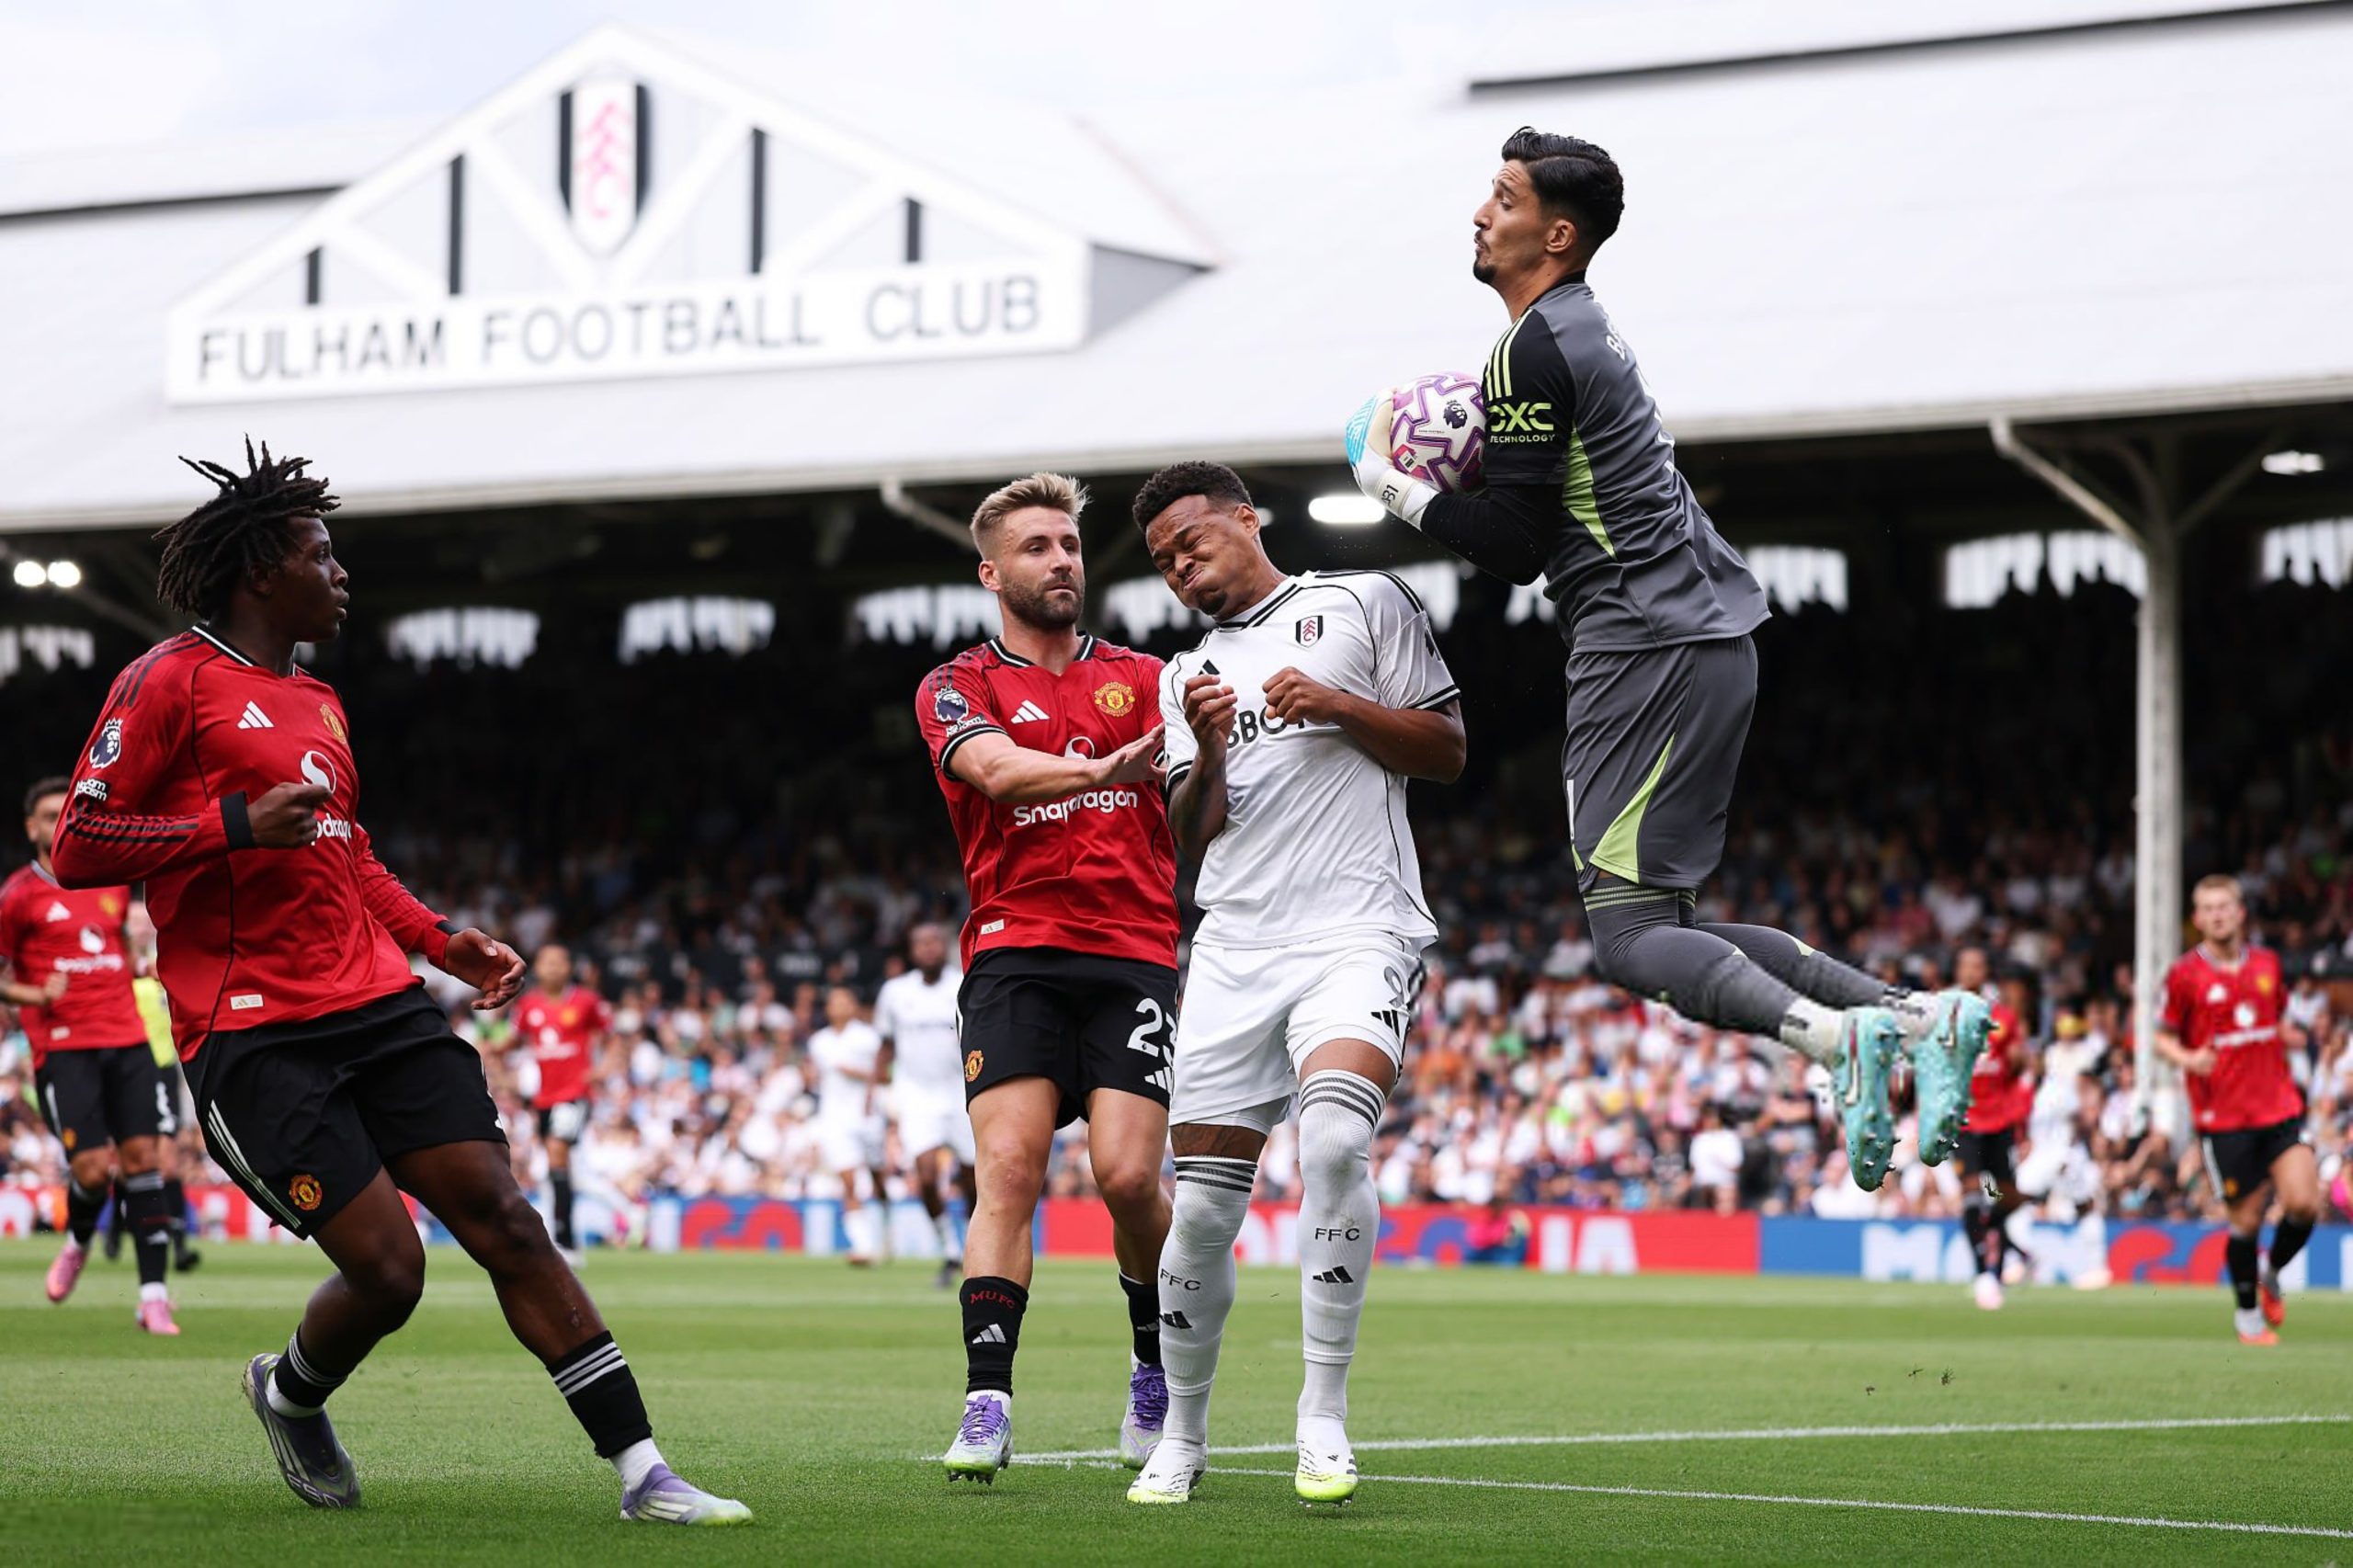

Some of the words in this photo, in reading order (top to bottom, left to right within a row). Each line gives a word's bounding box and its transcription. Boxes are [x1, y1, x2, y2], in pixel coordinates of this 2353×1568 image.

[199, 318, 447, 381] FULHAM
[482, 287, 823, 365] FOOTBALL
[865, 275, 1040, 343] CLUB
[1314, 1227, 1360, 1242] FFC
[1160, 1267, 1201, 1291] FFC
[970, 1290, 1016, 1310] MUFC
